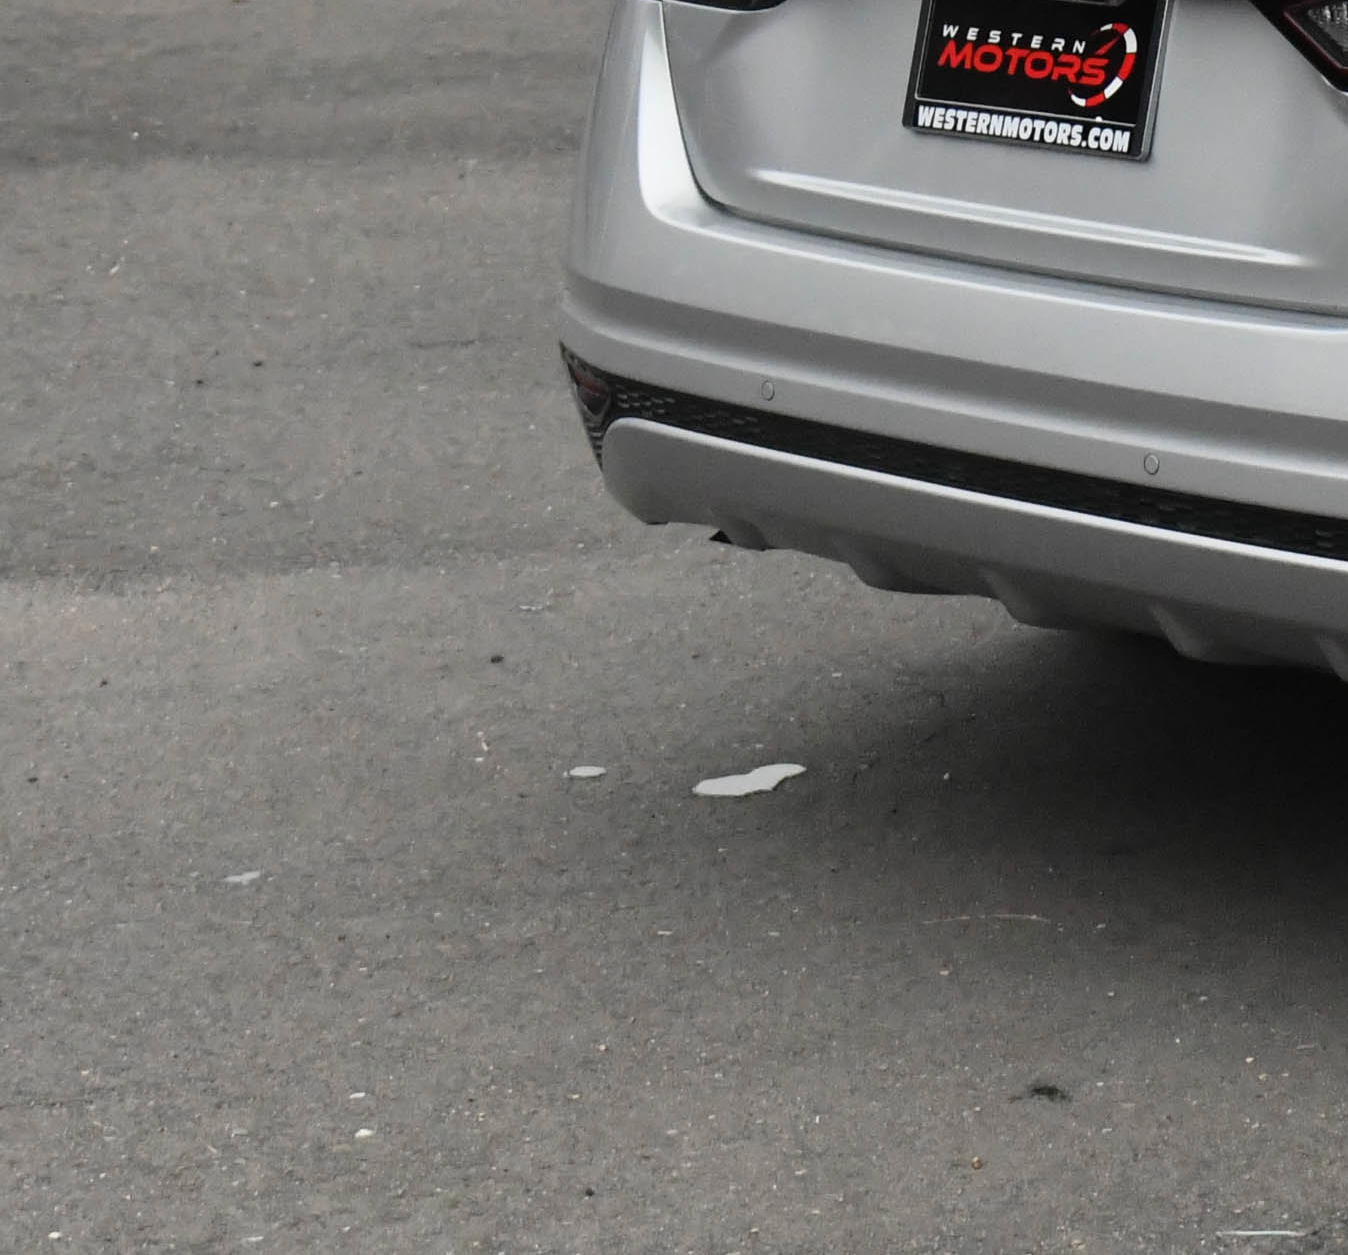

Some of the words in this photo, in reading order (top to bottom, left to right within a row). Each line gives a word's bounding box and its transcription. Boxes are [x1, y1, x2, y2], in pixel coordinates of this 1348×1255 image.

[941, 24, 1087, 54] WESTERN
[937, 40, 1110, 86] MOTORS
[917, 105, 1131, 153] WESTERNMOTORS.COM
